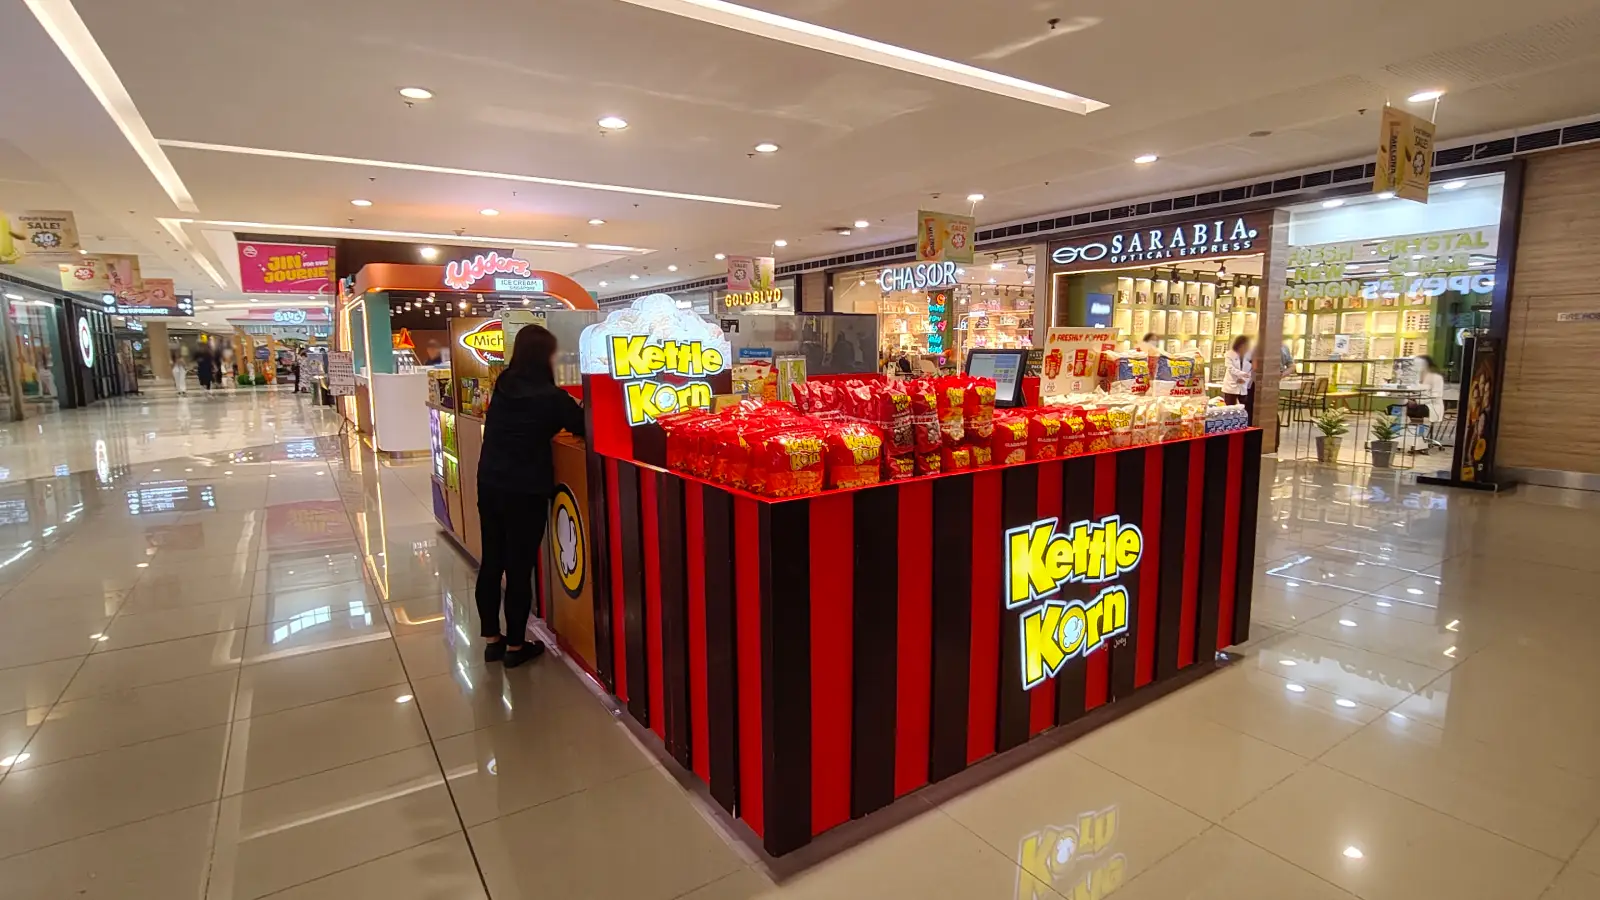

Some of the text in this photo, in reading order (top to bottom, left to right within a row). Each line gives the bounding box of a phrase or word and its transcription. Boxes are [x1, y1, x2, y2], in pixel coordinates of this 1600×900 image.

[1112, 217, 1247, 254] SARABIA
[1377, 231, 1489, 255] CRYSTAL
[267, 255, 301, 271] JIN
[1111, 241, 1251, 264] OPTICAL EXPRESS
[1294, 264, 1342, 281] NEW
[1281, 280, 1360, 299] DESIGN
[610, 334, 723, 378] Kettle
[626, 381, 711, 424] Korn
[1007, 515, 1142, 608] Kettle
[1021, 586, 1127, 689] Korn
